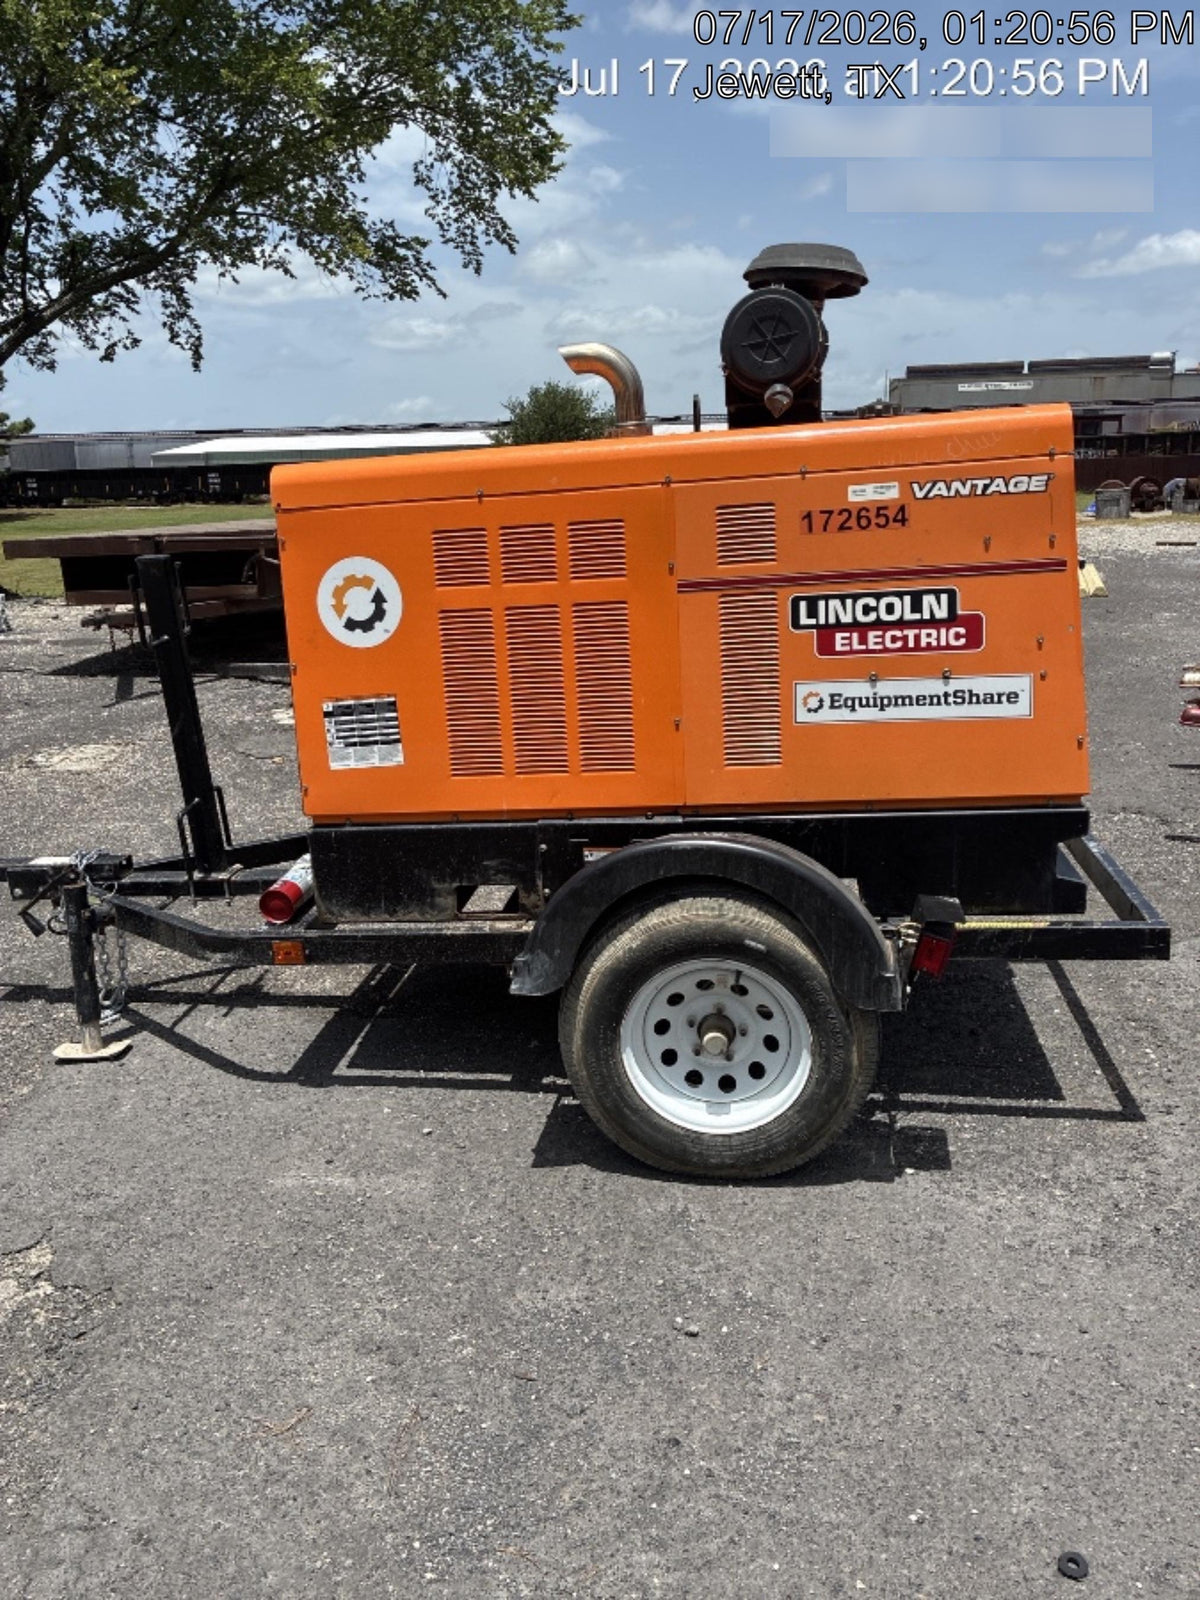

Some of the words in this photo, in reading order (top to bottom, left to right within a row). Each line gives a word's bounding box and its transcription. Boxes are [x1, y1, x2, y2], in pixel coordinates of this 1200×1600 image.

[910, 474, 1050, 500] VANTAGE
[801, 504, 909, 534] 172654
[799, 593, 949, 625] LINCOLN
[834, 626, 967, 652] ELECTRIC
[827, 688, 1021, 713] EquipmentShare
